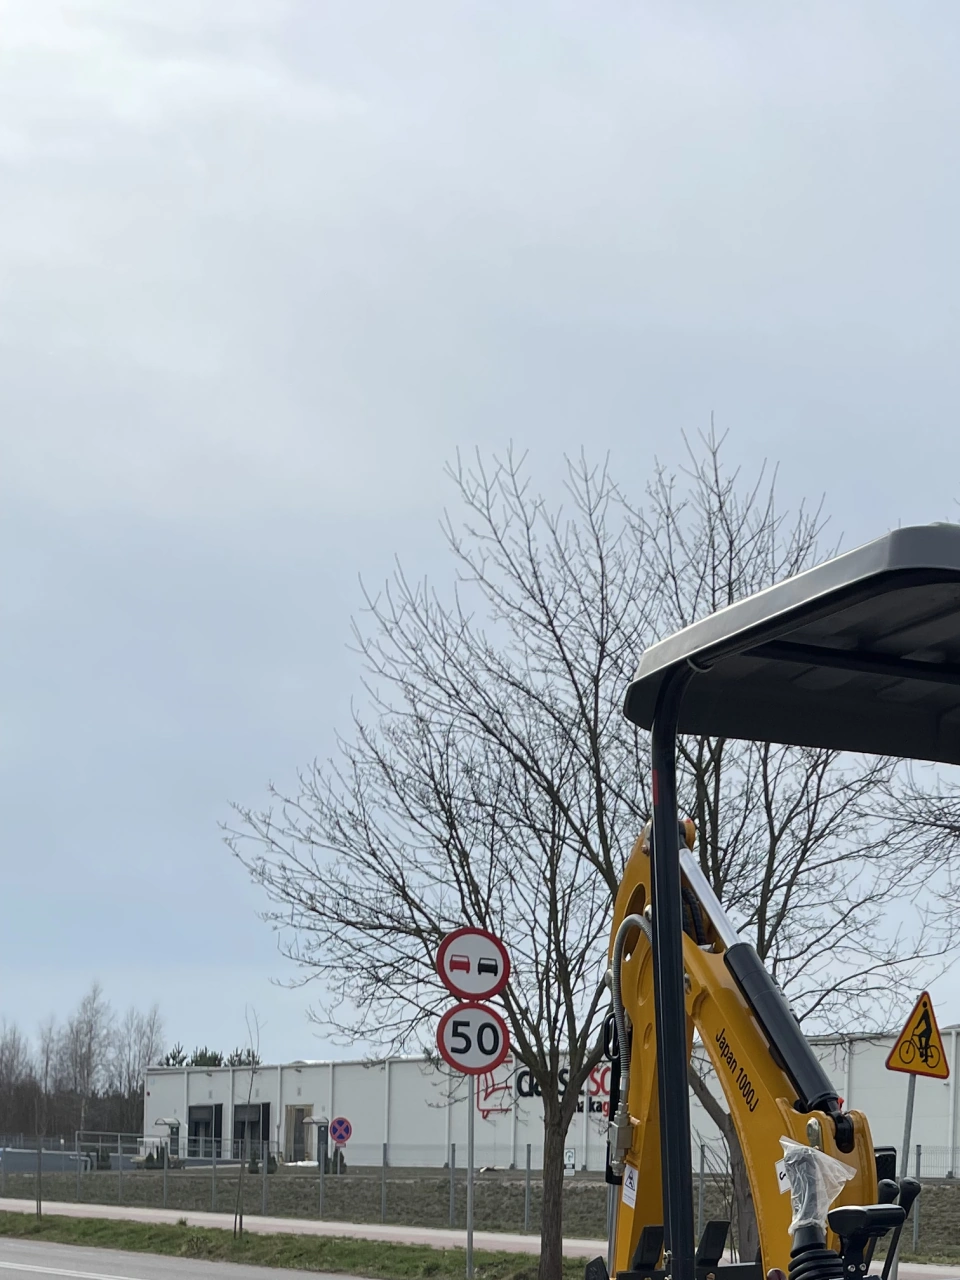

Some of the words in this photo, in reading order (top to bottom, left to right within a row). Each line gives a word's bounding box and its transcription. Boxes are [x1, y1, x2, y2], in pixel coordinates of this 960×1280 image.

[450, 1020, 500, 1056] 50
[715, 1028, 738, 1074] Japan
[735, 1067, 760, 1113] 1000J
